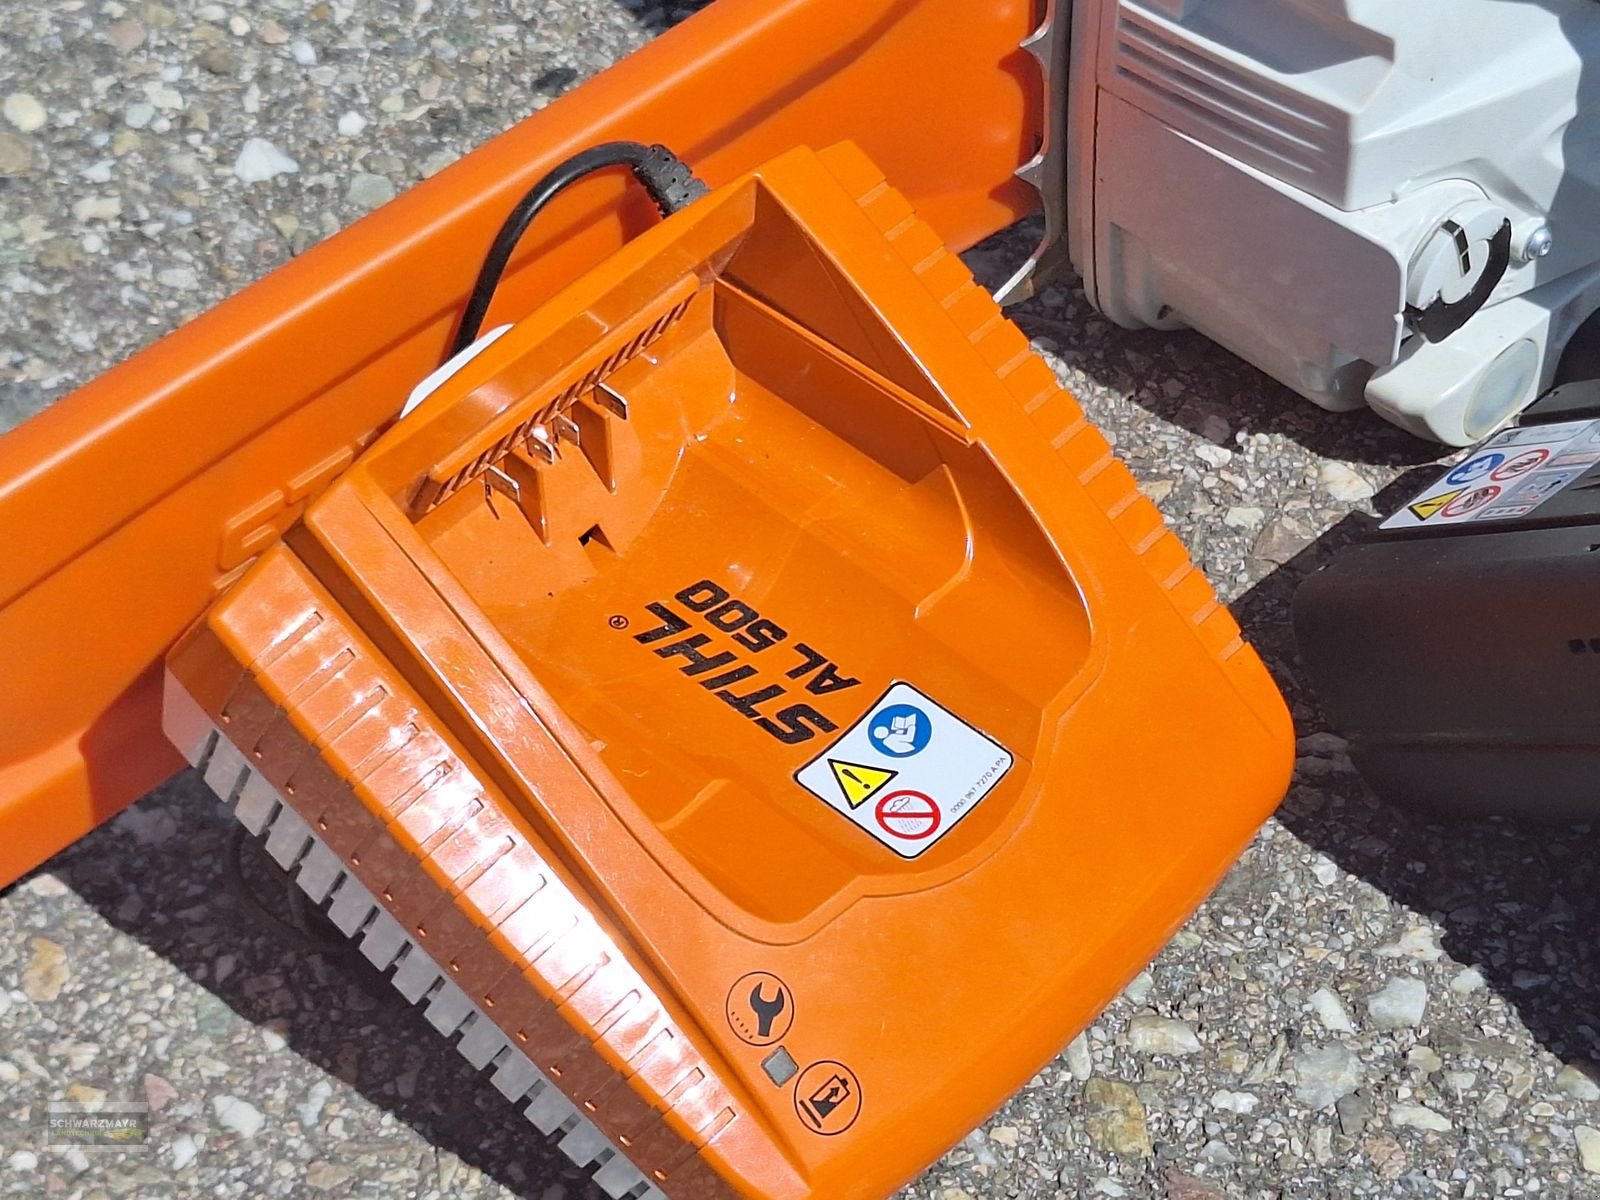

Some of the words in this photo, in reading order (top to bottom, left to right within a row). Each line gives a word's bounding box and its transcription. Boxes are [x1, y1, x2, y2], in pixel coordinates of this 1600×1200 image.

[674, 580, 788, 652] 500
[633, 602, 838, 744] STIHL
[786, 643, 861, 694] AL
